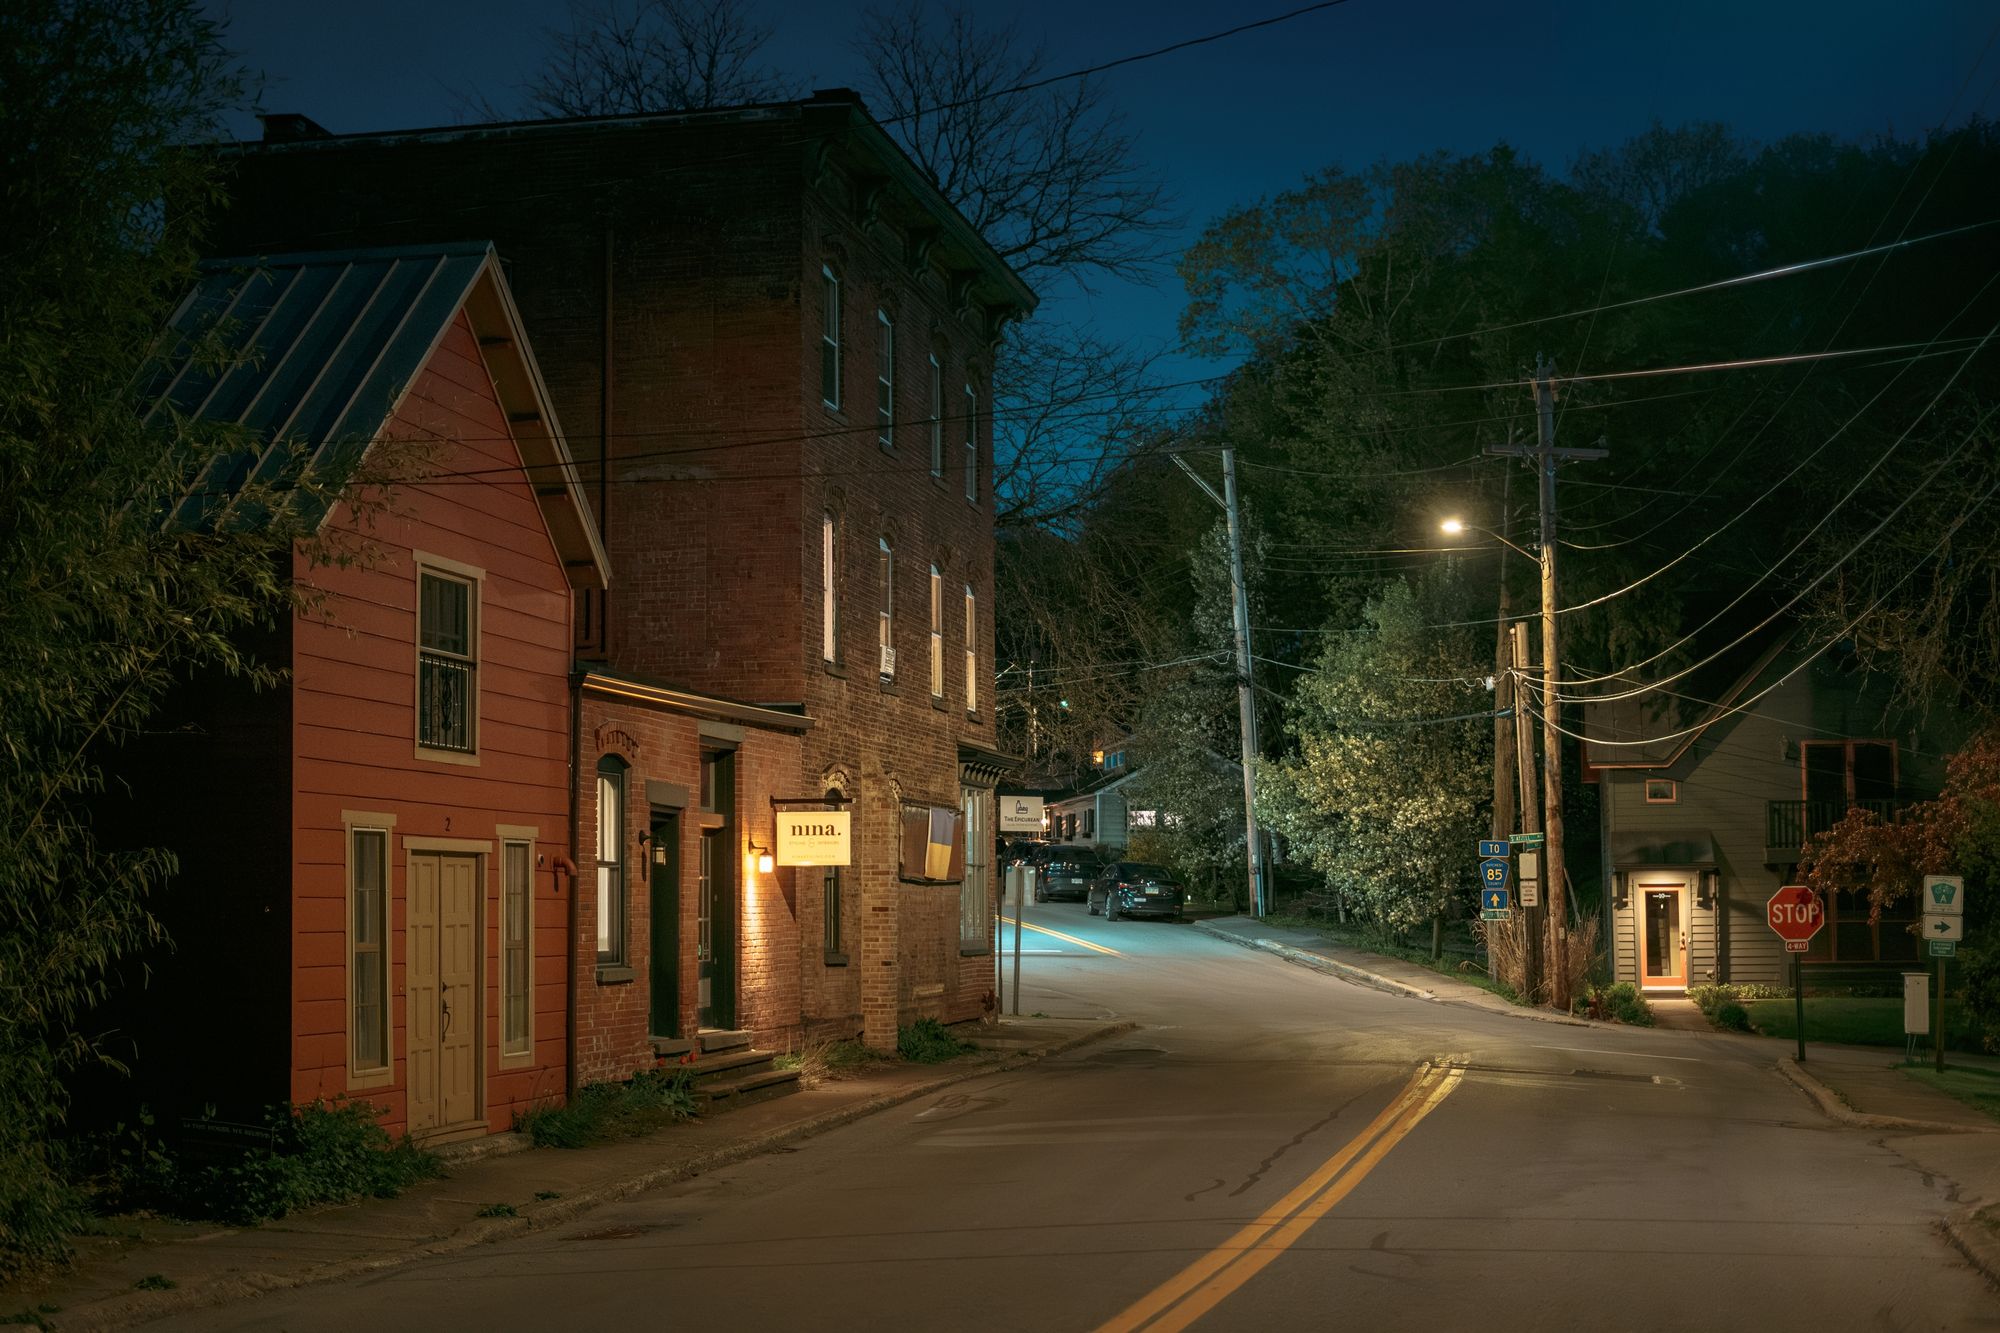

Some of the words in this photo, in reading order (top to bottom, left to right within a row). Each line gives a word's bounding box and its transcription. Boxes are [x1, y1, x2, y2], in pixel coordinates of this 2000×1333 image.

[444, 816, 451, 832] 2
[791, 824, 841, 836] nina.
[1489, 844, 1500, 854] TO
[1487, 869, 1503, 881] 85
[1772, 904, 1820, 924] STOP
